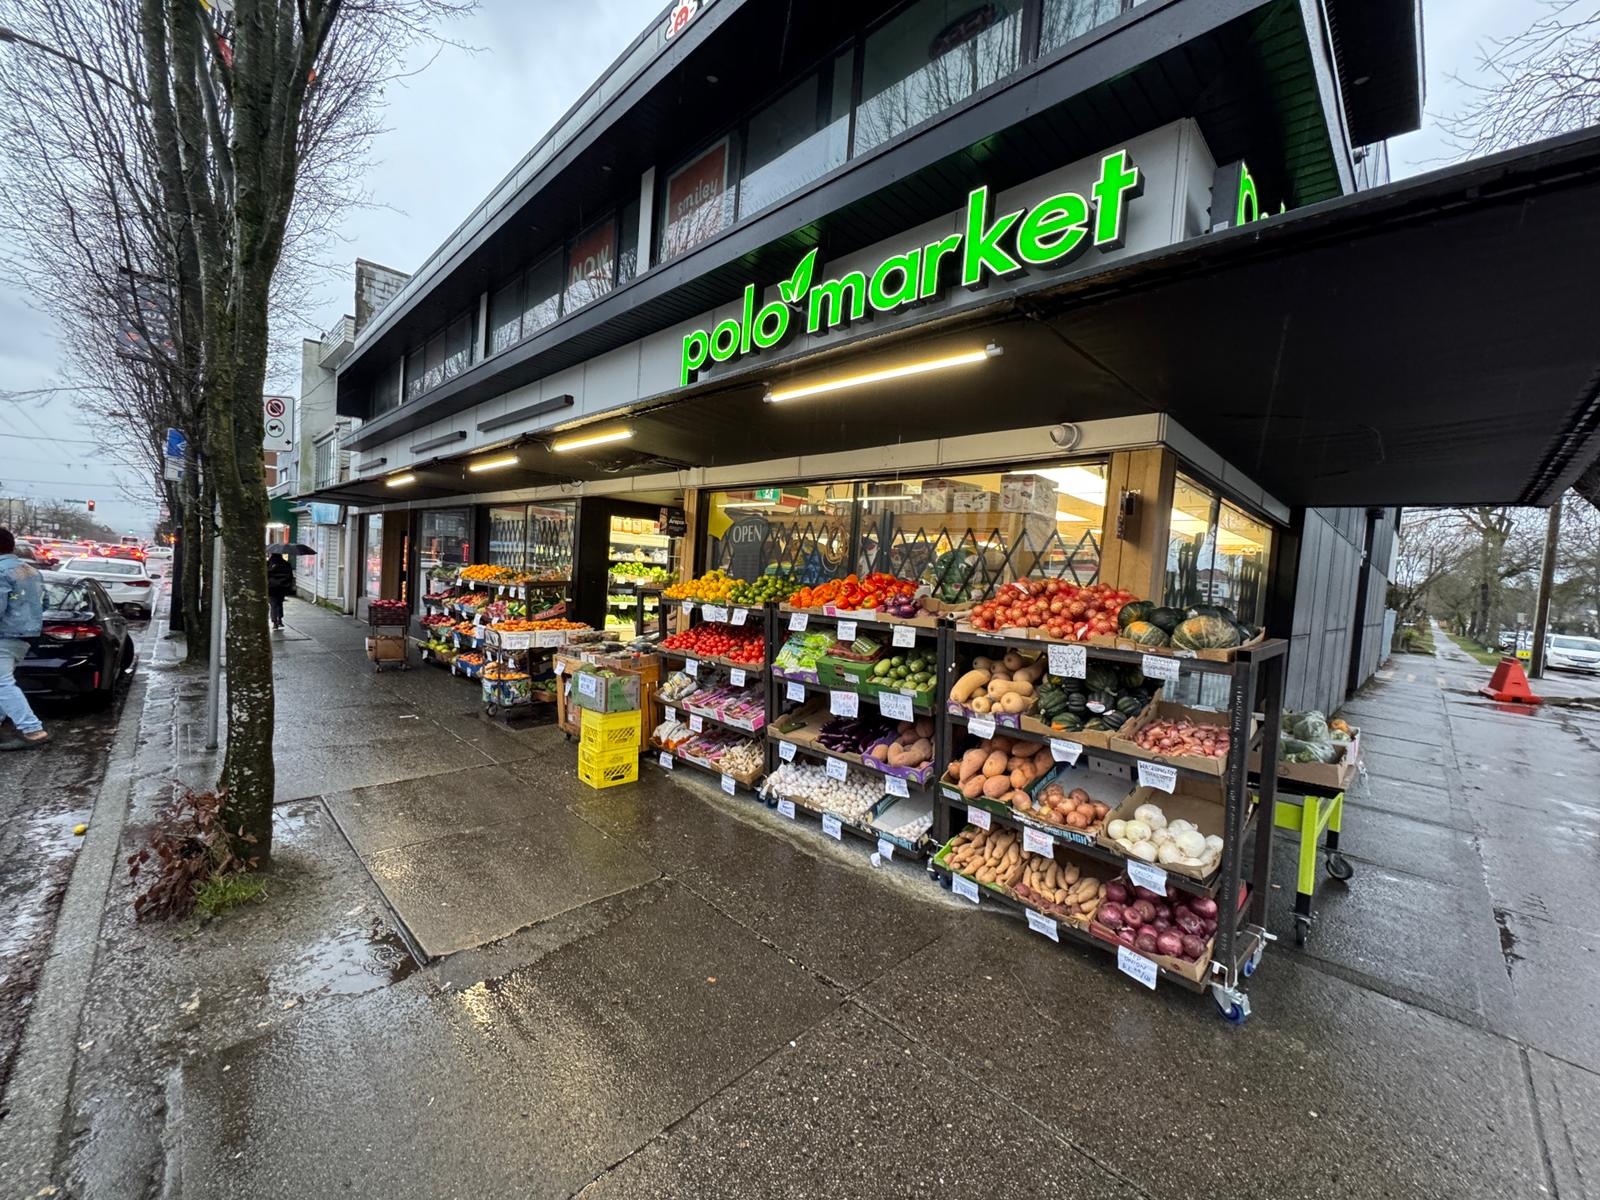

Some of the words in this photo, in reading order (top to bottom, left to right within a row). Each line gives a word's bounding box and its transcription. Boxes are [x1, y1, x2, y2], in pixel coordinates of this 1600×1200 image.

[677, 178, 719, 217] smiley
[571, 244, 610, 285] NOW
[679, 283, 790, 389] polo
[807, 149, 1139, 334] market
[732, 524, 763, 544] OPEN
